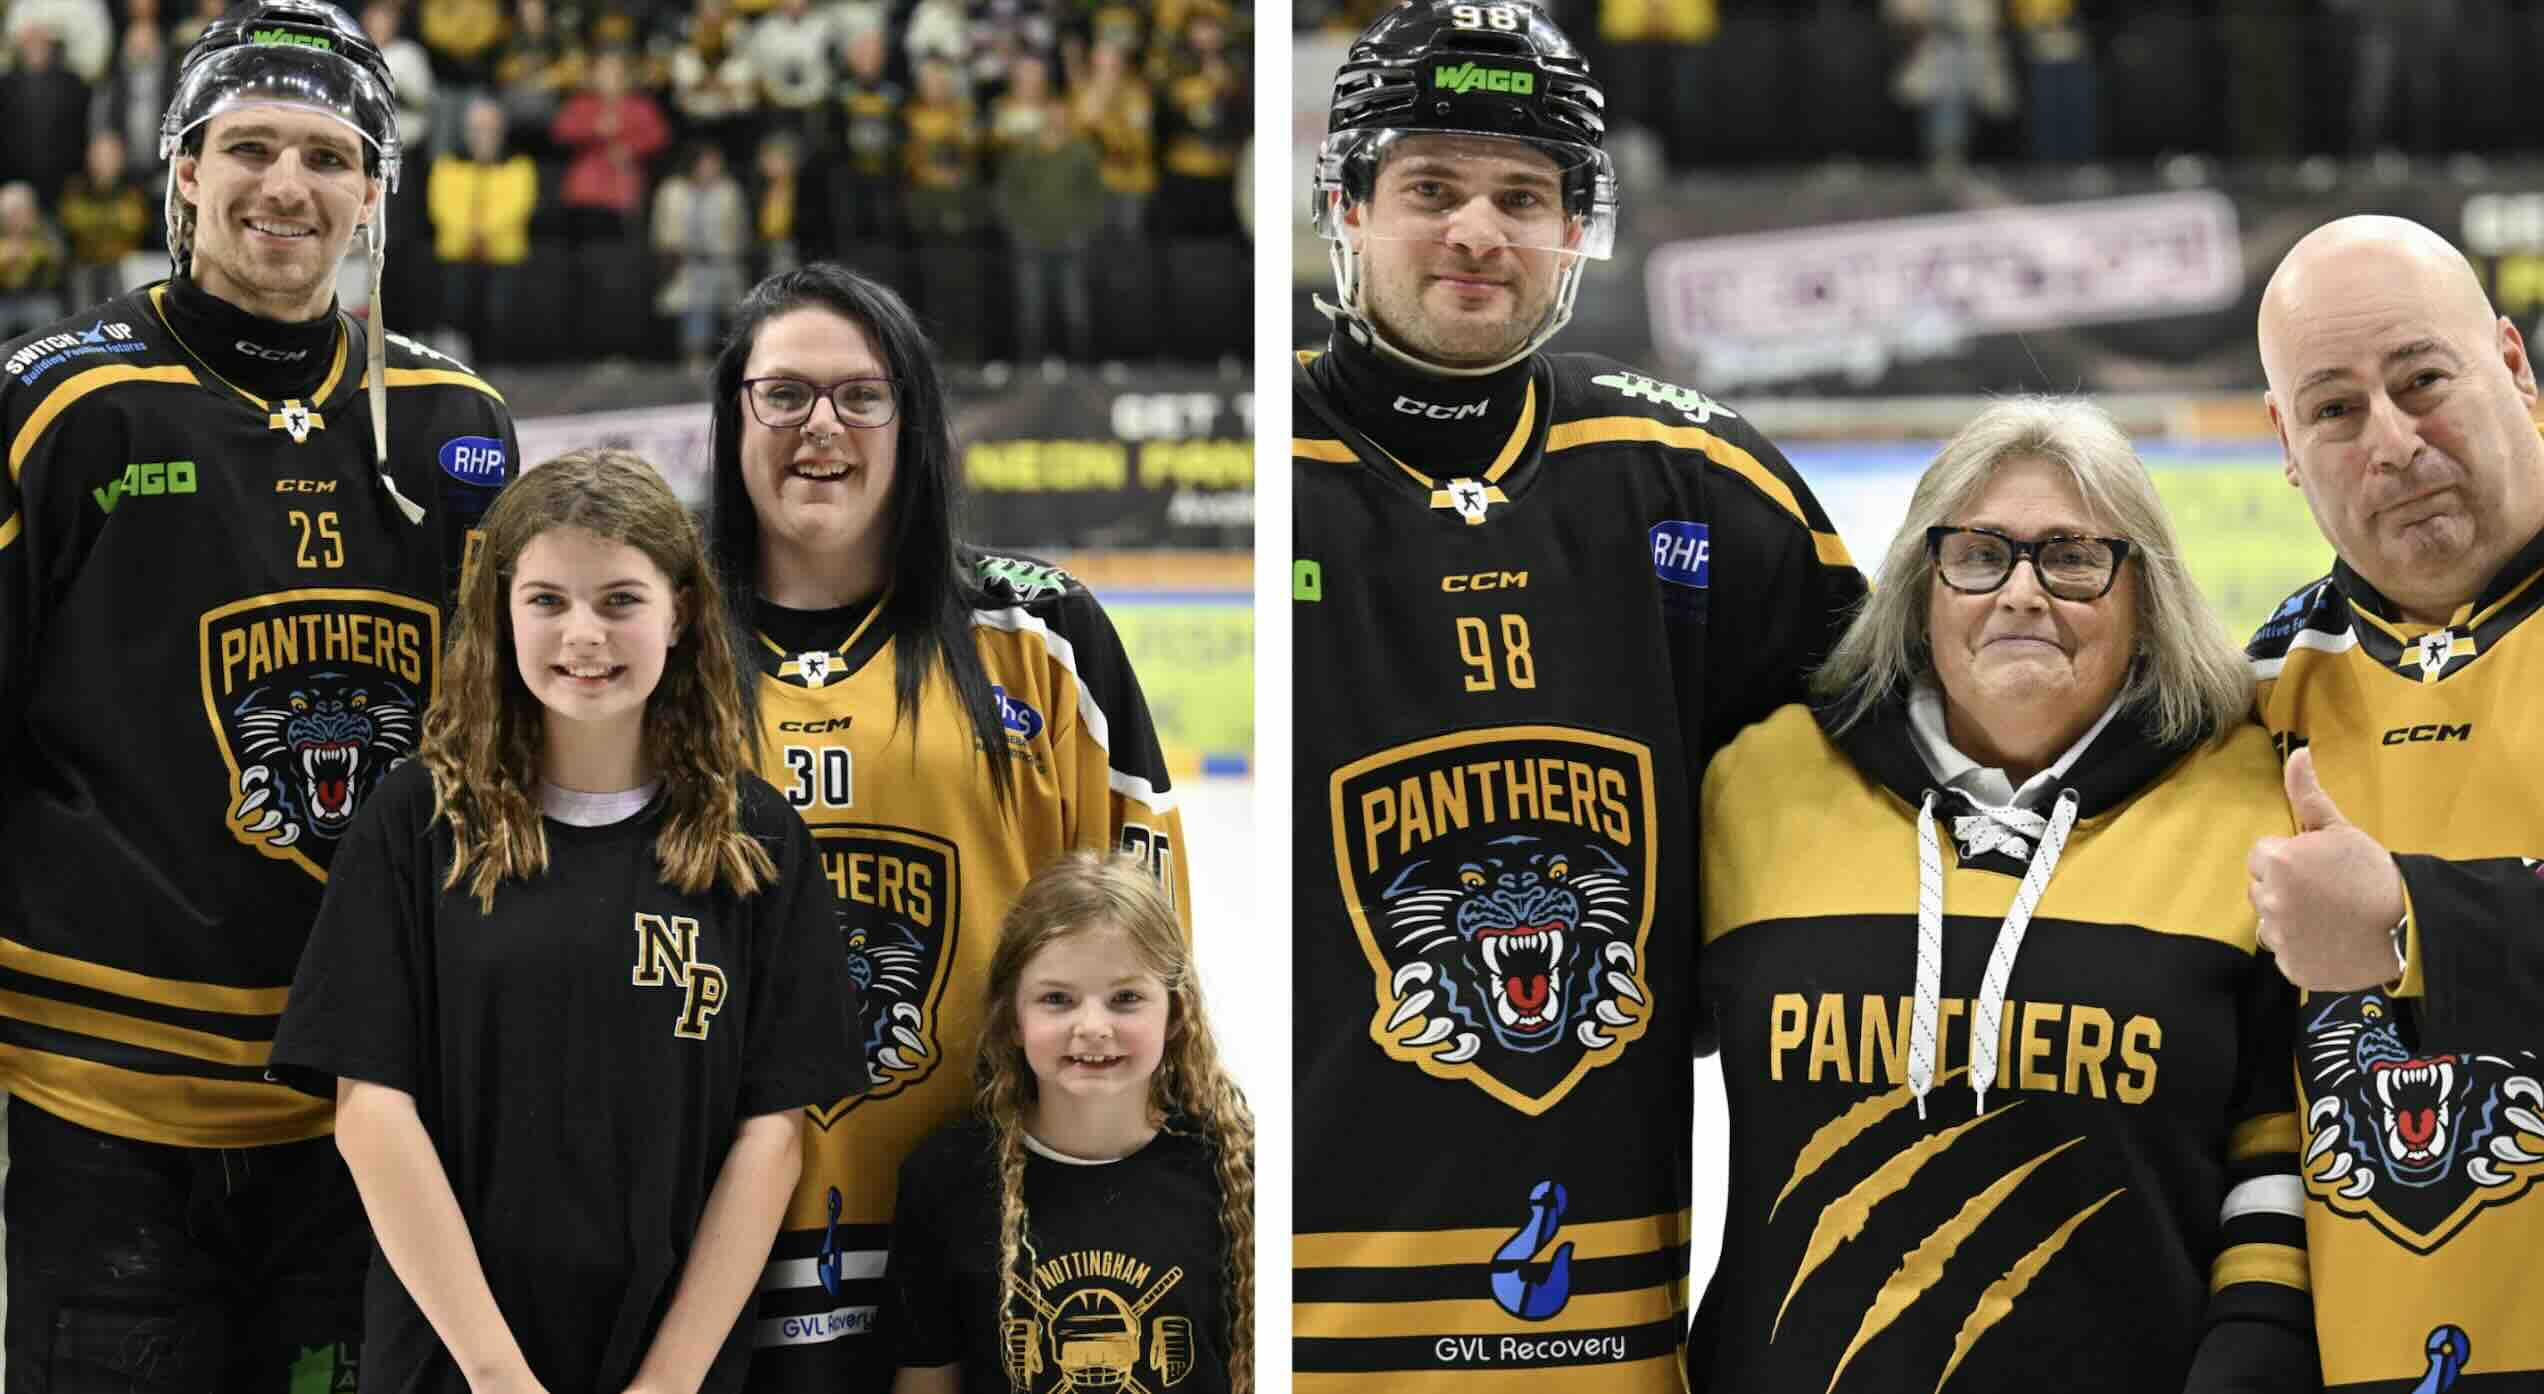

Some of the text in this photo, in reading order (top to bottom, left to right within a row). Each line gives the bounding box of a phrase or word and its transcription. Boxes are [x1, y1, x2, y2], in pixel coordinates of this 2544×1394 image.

[1451, 4, 1518, 30] 98
[1434, 61, 1535, 95] WAGO
[5, 322, 132, 375] SWITCH UP
[234, 339, 308, 361] CCM
[1393, 395, 1490, 421] CCM
[274, 479, 338, 494] CCM
[288, 510, 345, 569] 25
[1440, 571, 1530, 593] CCM
[221, 612, 422, 696] PANTHERS
[1455, 613, 1537, 692] 98
[779, 715, 853, 734] CCM
[2382, 723, 2473, 746] CCM
[783, 744, 854, 811] 30
[1361, 758, 1632, 875] PANTHERS
[820, 851, 934, 929] HERS
[1035, 1249, 1152, 1290] NOTTINGHAM
[783, 1316, 824, 1338] GVL
[1435, 1335, 1626, 1361] GVL Recovery
